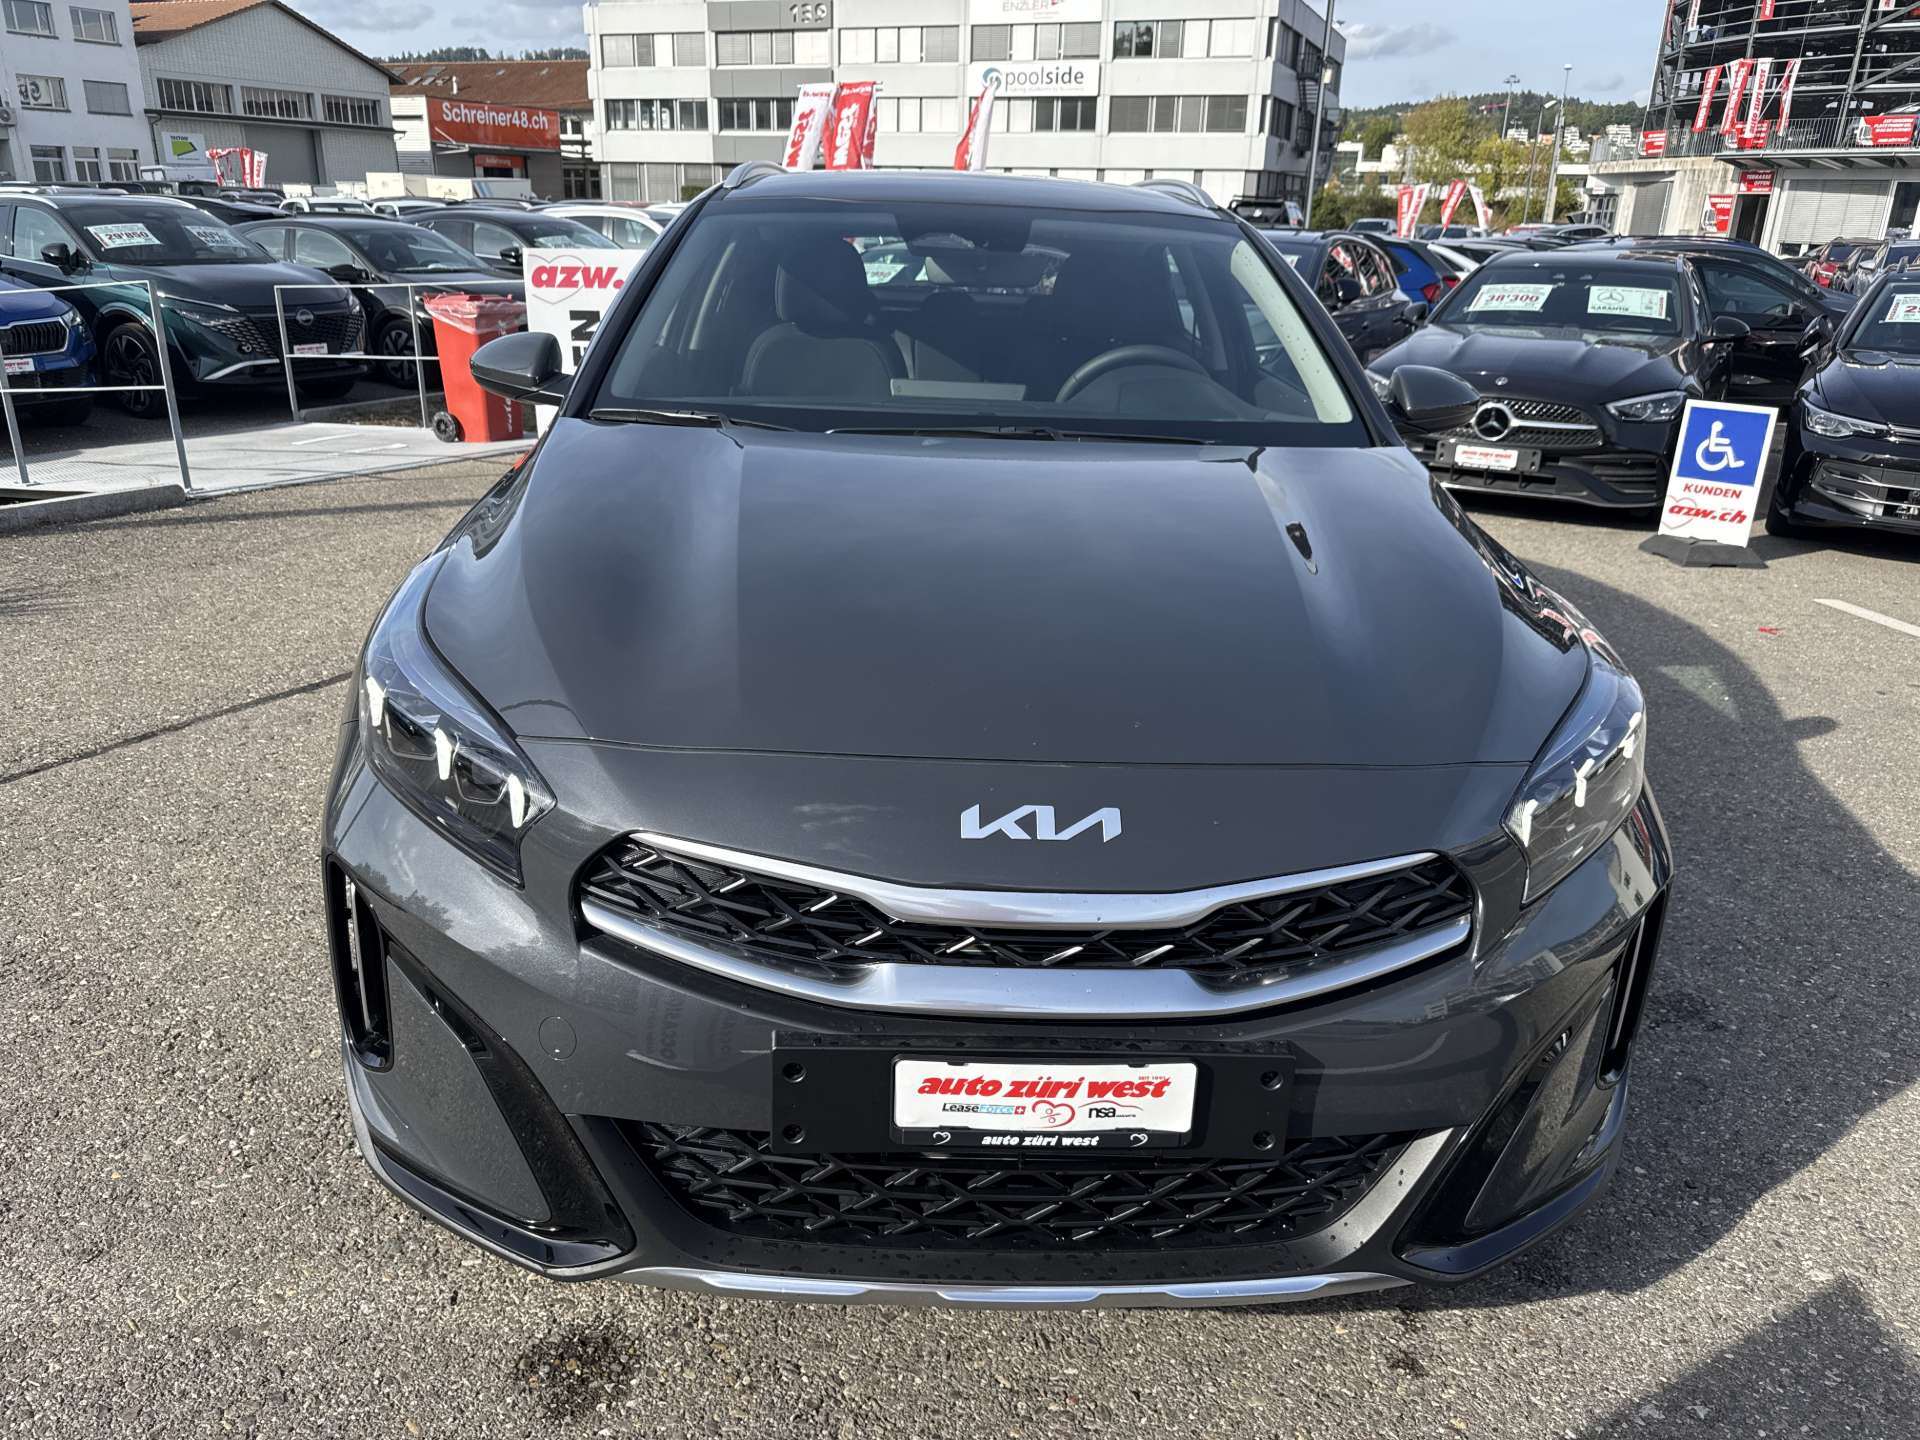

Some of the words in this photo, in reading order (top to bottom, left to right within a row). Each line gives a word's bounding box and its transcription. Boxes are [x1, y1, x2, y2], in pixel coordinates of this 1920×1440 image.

[1005, 65, 1084, 92] poolside
[442, 101, 548, 130] Schreiner48.ch
[1683, 483, 1742, 499] KUNDEN
[1668, 505, 1748, 524] azw.ch
[961, 804, 1121, 843] KIA
[917, 1074, 1002, 1096] auto
[1002, 1076, 1085, 1098] züri
[1087, 1077, 1171, 1098] west
[1088, 1107, 1116, 1118] nsa
[982, 1135, 1019, 1145] auto
[1022, 1135, 1058, 1146] züri
[1062, 1135, 1099, 1146] west
